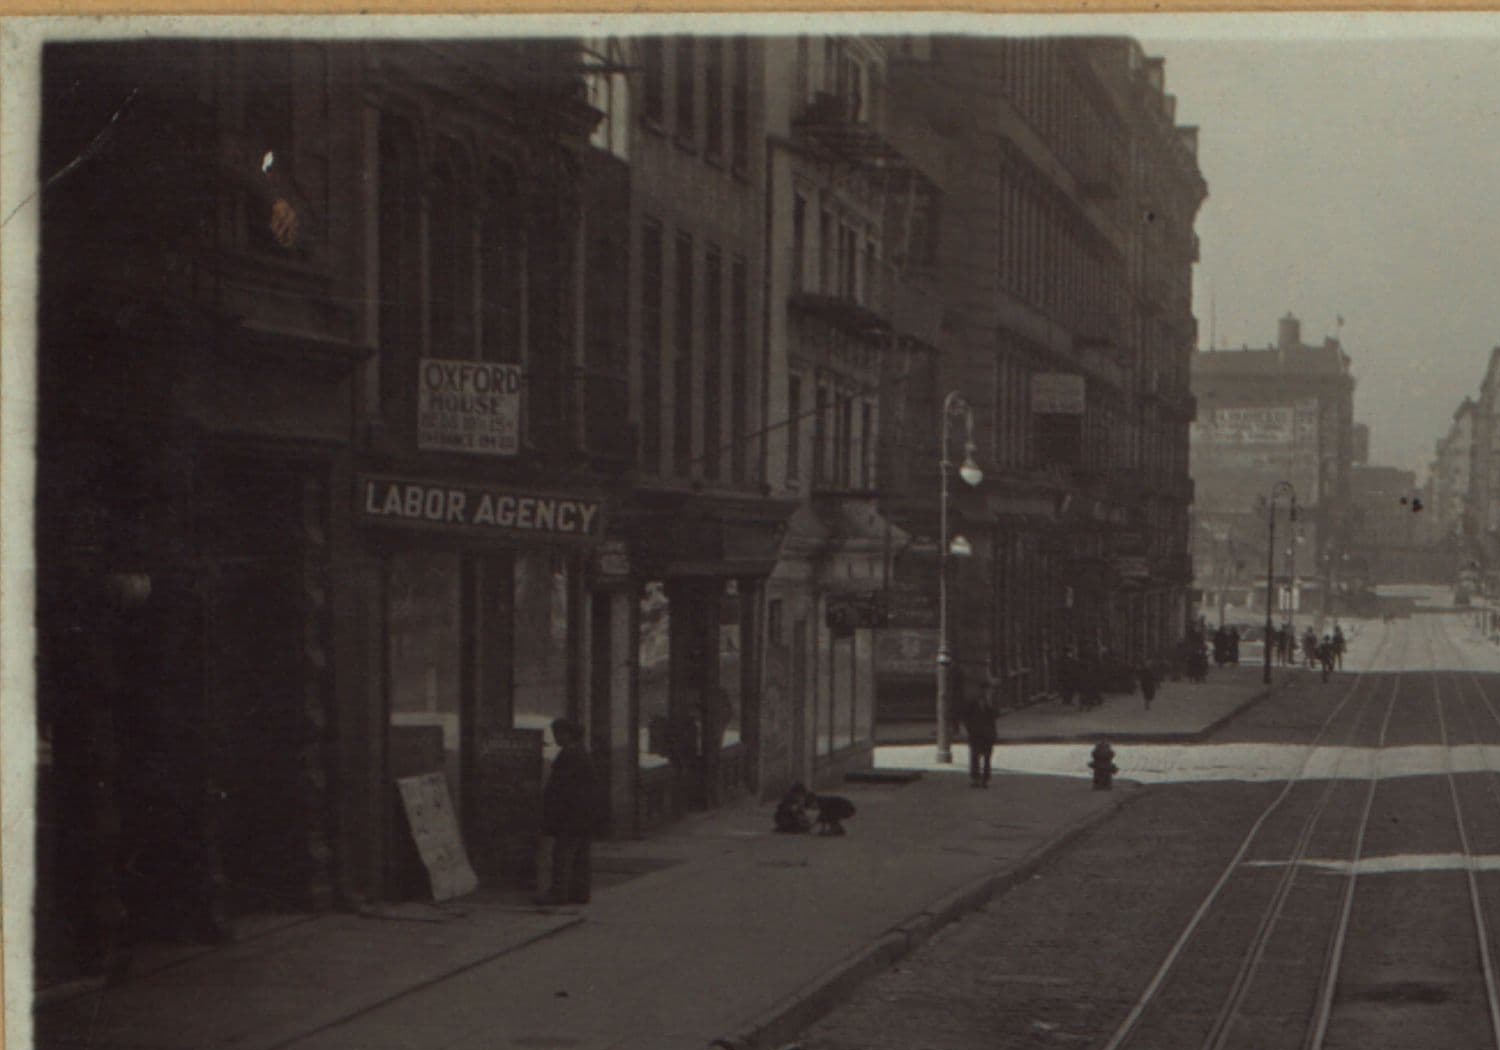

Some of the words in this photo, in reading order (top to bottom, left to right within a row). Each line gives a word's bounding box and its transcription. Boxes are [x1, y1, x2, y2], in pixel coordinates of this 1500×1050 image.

[425, 363, 520, 394] OXFORD
[429, 394, 504, 415] HOUSE
[364, 480, 467, 524] LABOR
[472, 492, 599, 535] AGENCY
